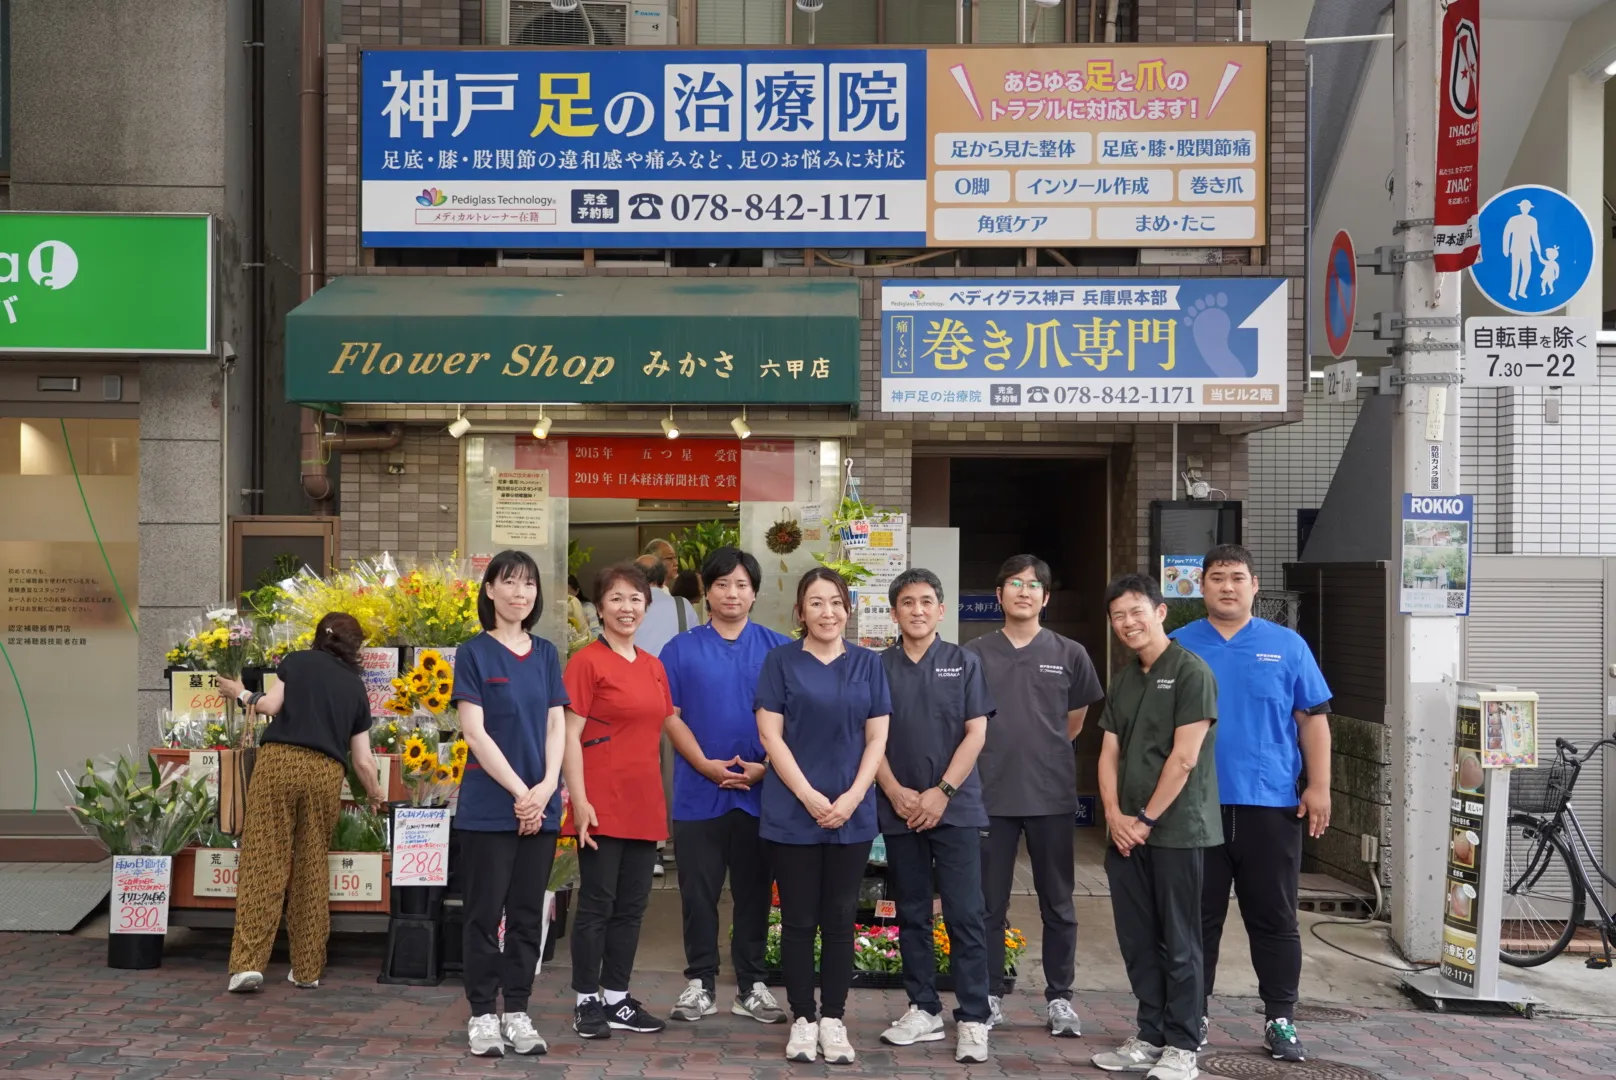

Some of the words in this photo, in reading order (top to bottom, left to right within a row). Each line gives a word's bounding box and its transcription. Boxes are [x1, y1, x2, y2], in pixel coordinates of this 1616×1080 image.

[1003, 59, 1189, 93] あらゆる足と爪の
[1448, 124, 1470, 138] INAC
[950, 140, 1076, 158] 足から見た整体
[1102, 138, 1251, 158] 足底・膝・股関節痛
[381, 149, 905, 170] 足底・膝・股関節の違和感や痛みなど、足のお悩みに対応
[955, 178, 990, 195] O脚
[1027, 176, 1150, 194] インソール作成
[1190, 176, 1244, 194] 巻き爪
[452, 194, 496, 206] Pediglass
[583, 192, 608, 206] 完全
[671, 193, 890, 221] 078-842-1171
[433, 212, 540, 223] メディカルトレーナー在籍
[577, 206, 614, 220] 予約制
[977, 215, 1048, 234] 角質ケア
[1136, 214, 1216, 232] まめ・たこ
[950, 289, 1075, 306] ペディグラス神戸
[1082, 289, 1168, 306] 兵庫県本部
[896, 320, 908, 369] 痛くない
[920, 316, 1177, 372] 巻き爪専門
[1474, 326, 1588, 349] 自転車を除く
[328, 342, 491, 375] Flower
[501, 343, 615, 384] Shop
[642, 350, 734, 378] みかさ
[760, 357, 830, 380] 六甲店
[890, 390, 982, 403] 神戸足の治療院
[998, 386, 1014, 394] 完全
[1054, 386, 1195, 404] 078-842-1171
[1210, 388, 1273, 402] 当ビル2階
[994, 394, 1018, 404] 予約制
[714, 449, 738, 462] 受賞
[1430, 446, 1439, 490] 防犯カメラ設置
[618, 474, 710, 488] 日本経済新聞社賞
[714, 474, 737, 488] 受賞
[1411, 498, 1464, 515] ROKKO
[190, 694, 225, 708] 680
[202, 756, 214, 764] DX
[334, 874, 360, 890] 150
